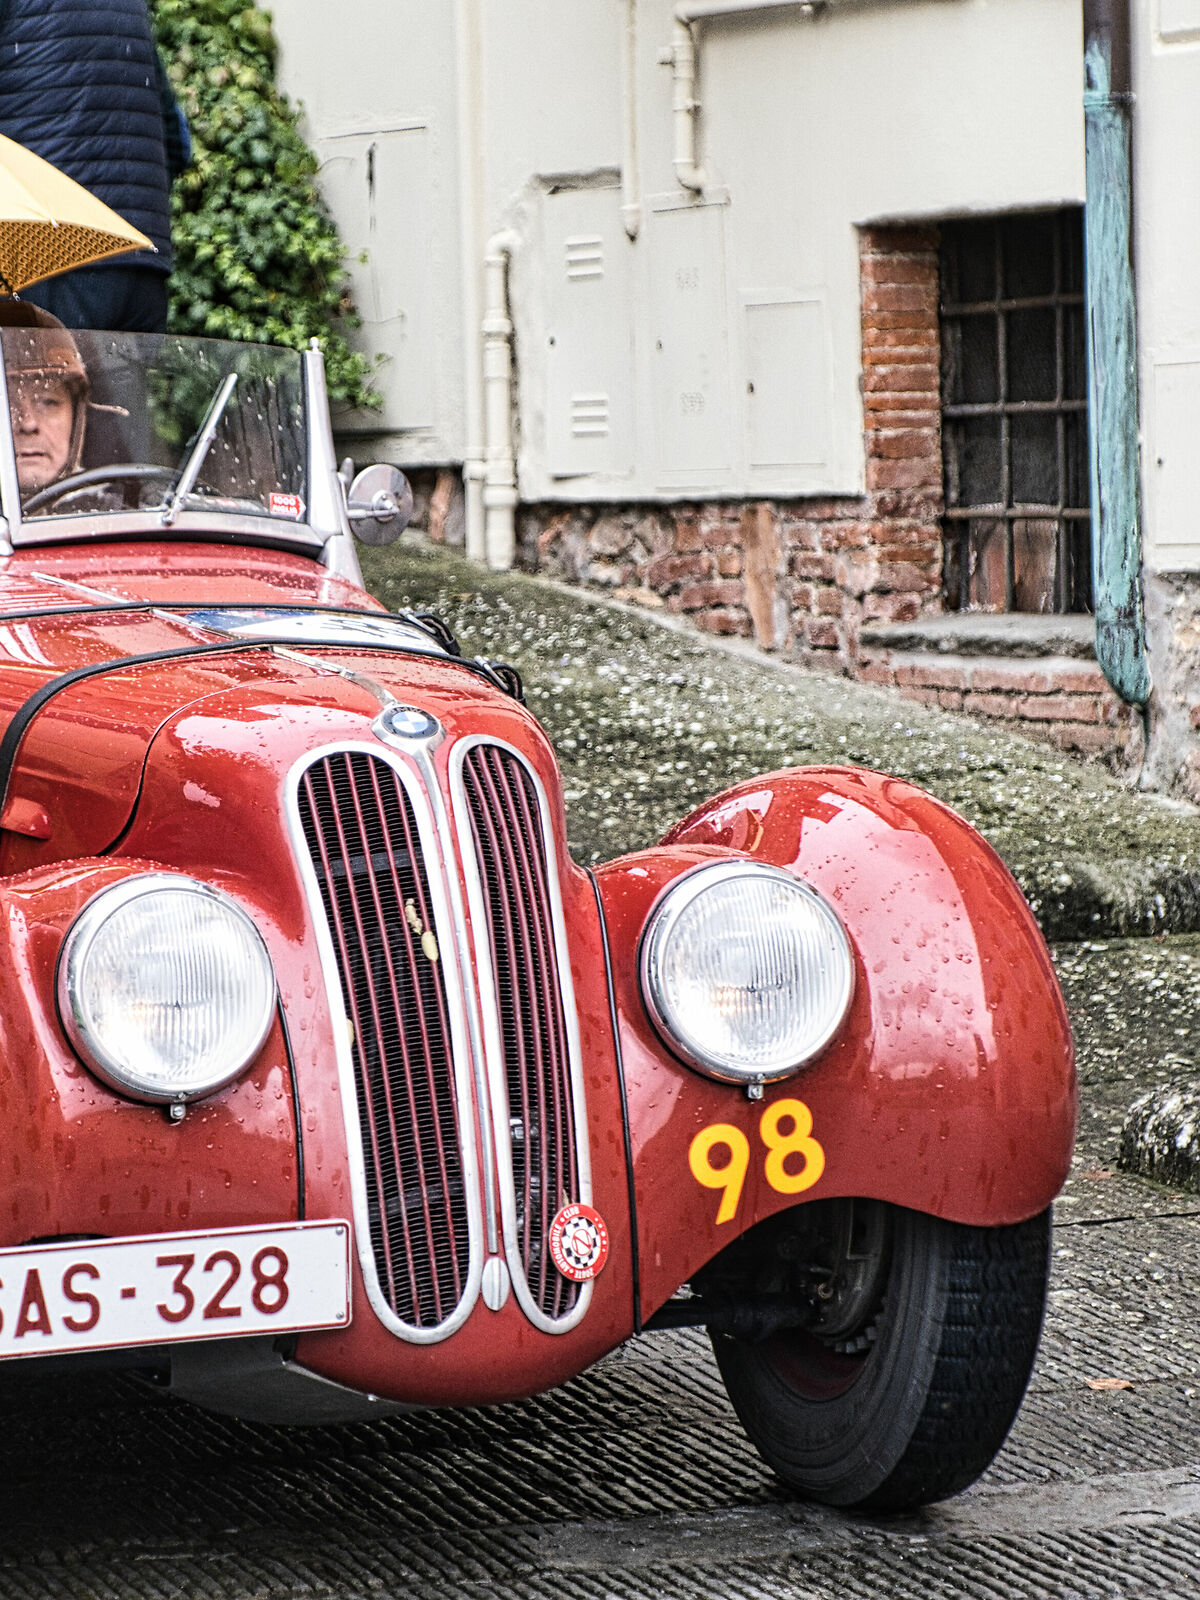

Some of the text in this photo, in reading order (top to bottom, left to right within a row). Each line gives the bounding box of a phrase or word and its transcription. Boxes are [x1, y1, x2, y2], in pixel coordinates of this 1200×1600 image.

[273, 495, 297, 506] 1000
[688, 1098, 826, 1226] 98
[552, 1223, 569, 1272] AUTOMOBILE
[563, 1206, 580, 1218] CLUB
